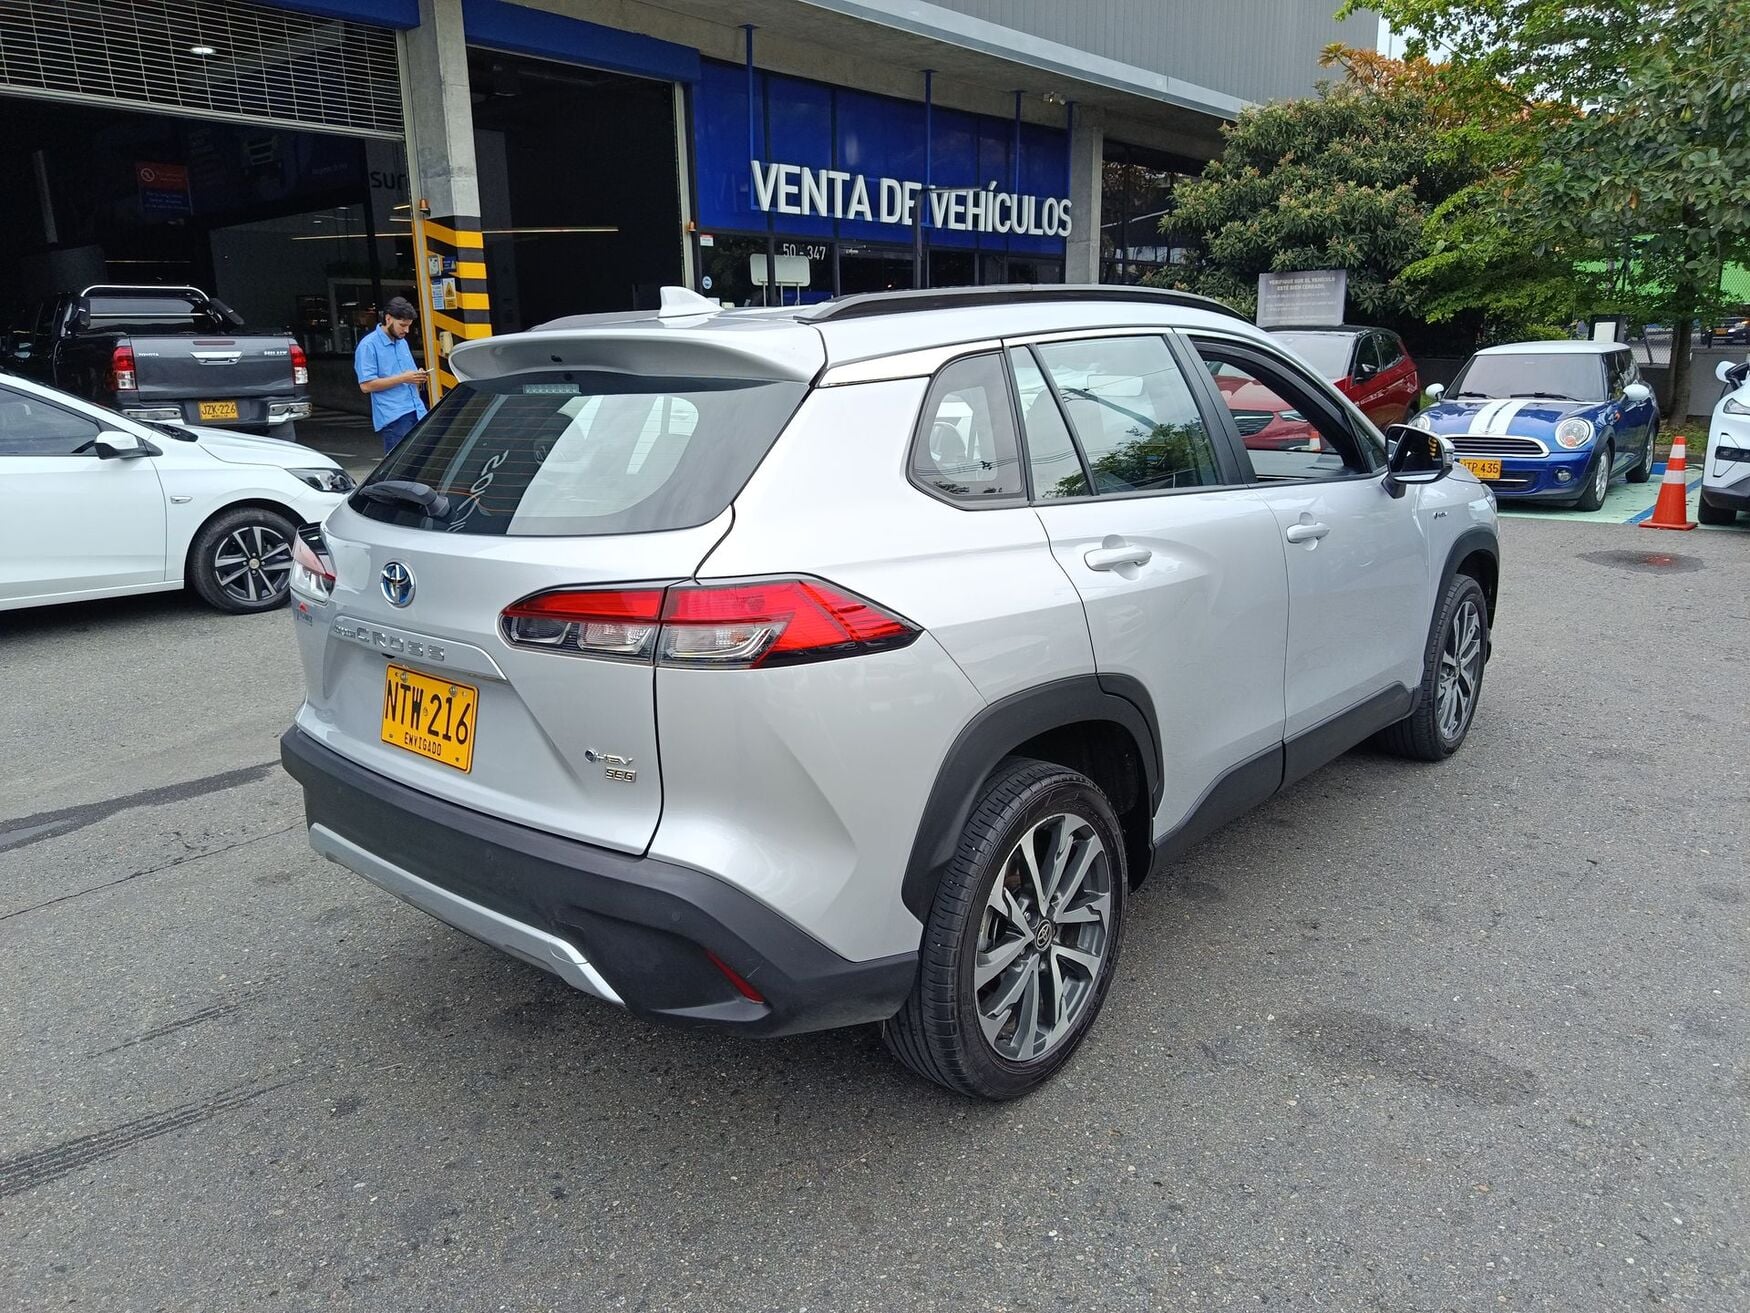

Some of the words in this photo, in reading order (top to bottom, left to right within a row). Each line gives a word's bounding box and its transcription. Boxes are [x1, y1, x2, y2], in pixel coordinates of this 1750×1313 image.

[751, 160, 873, 221] VENTA
[880, 177, 922, 226] DE
[929, 180, 1073, 237] VEHÍCULOS
[783, 243, 796, 257] 50
[807, 245, 826, 261] 347
[1480, 462, 1499, 474] 435
[356, 627, 445, 662] CROSS
[385, 679, 424, 731] NTW
[427, 693, 472, 746] 216
[404, 731, 443, 757] ENVIGADO
[606, 768, 634, 782] SEG
